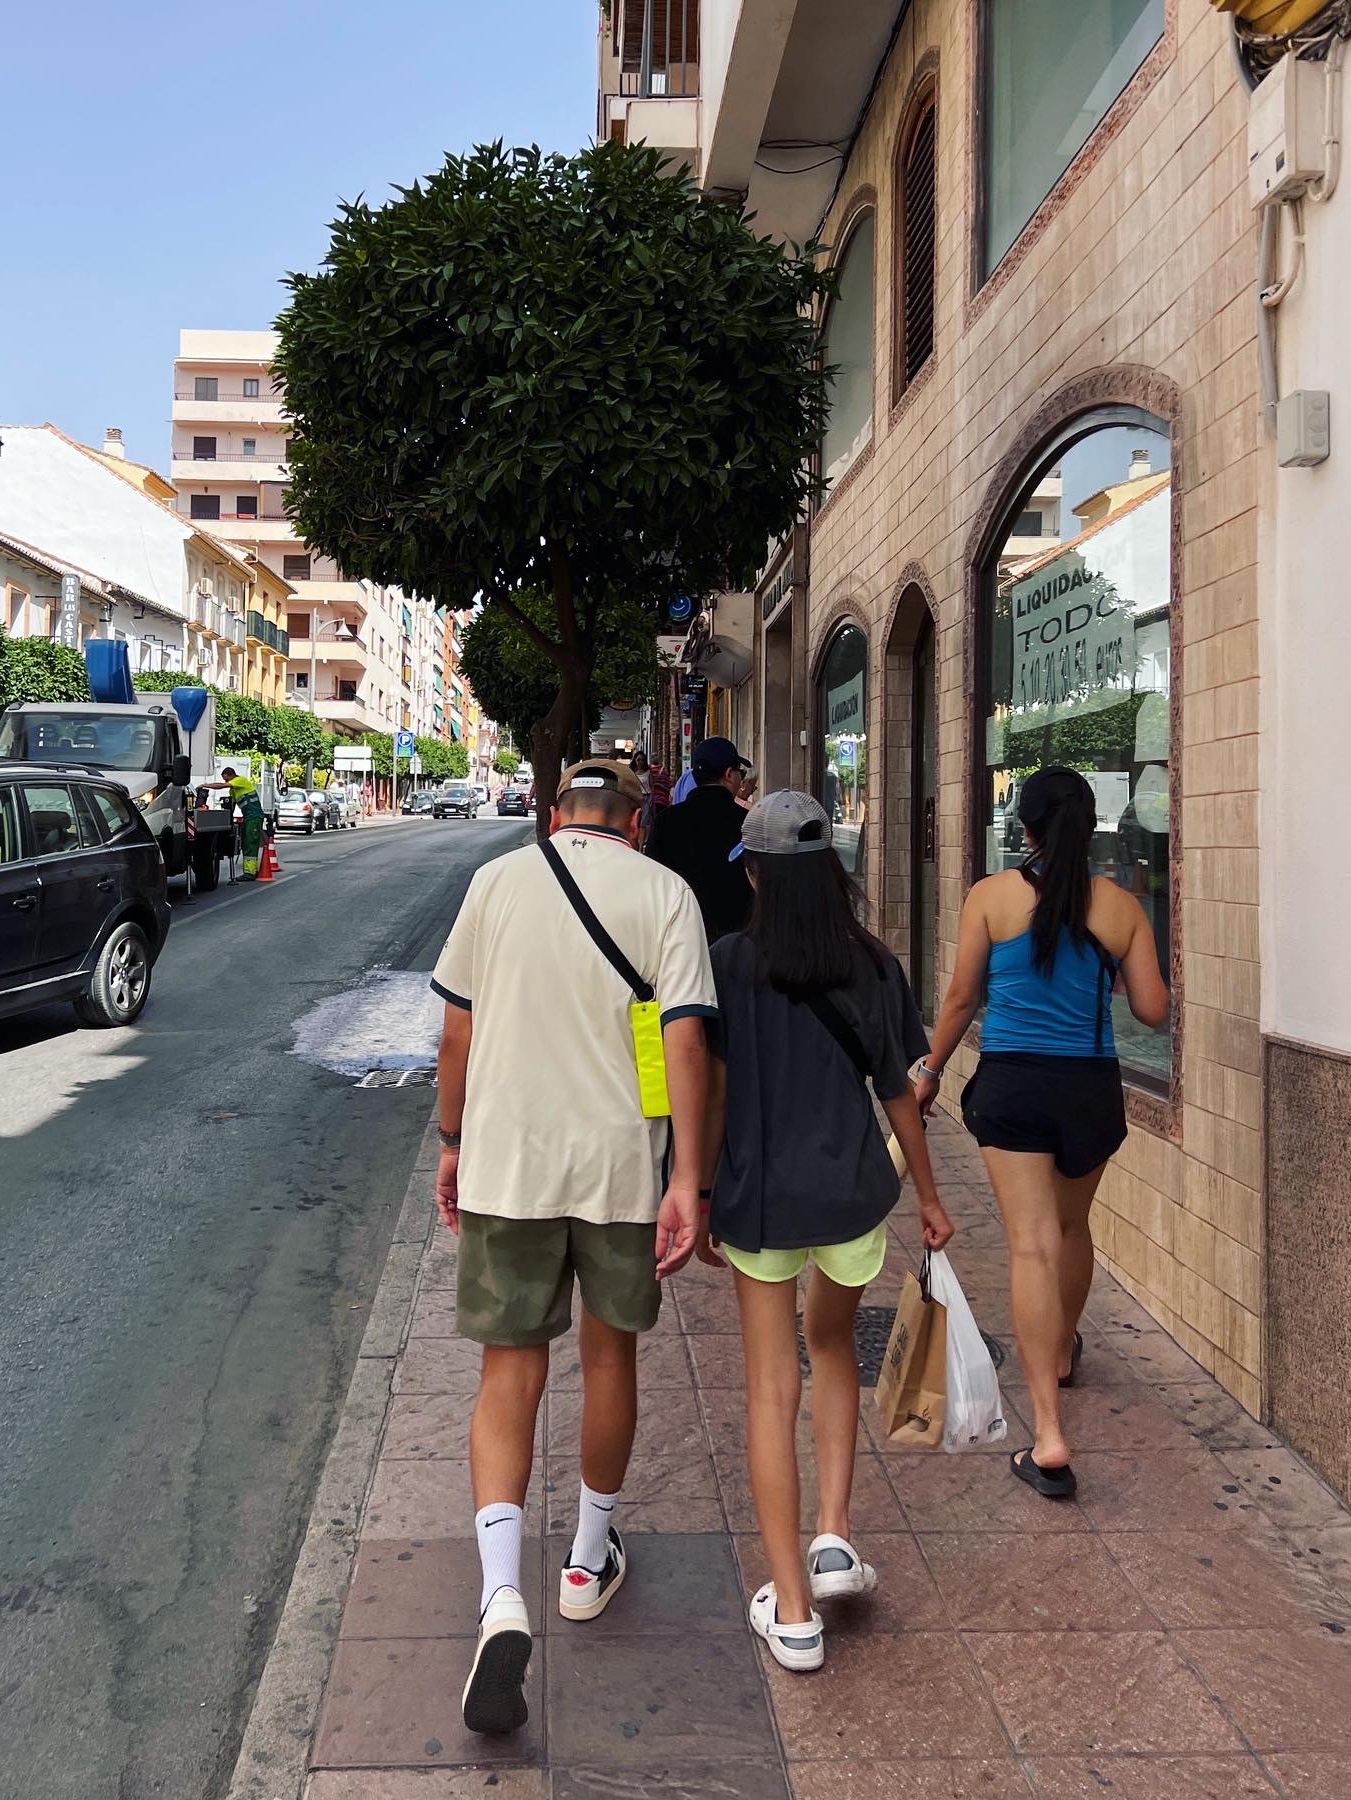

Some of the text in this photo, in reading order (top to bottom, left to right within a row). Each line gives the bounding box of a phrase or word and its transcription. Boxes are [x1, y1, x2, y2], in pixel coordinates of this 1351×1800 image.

[65, 577, 75, 602] BAR
[1016, 566, 1095, 618] LIQUIDAC
[401, 735, 410, 745] P
